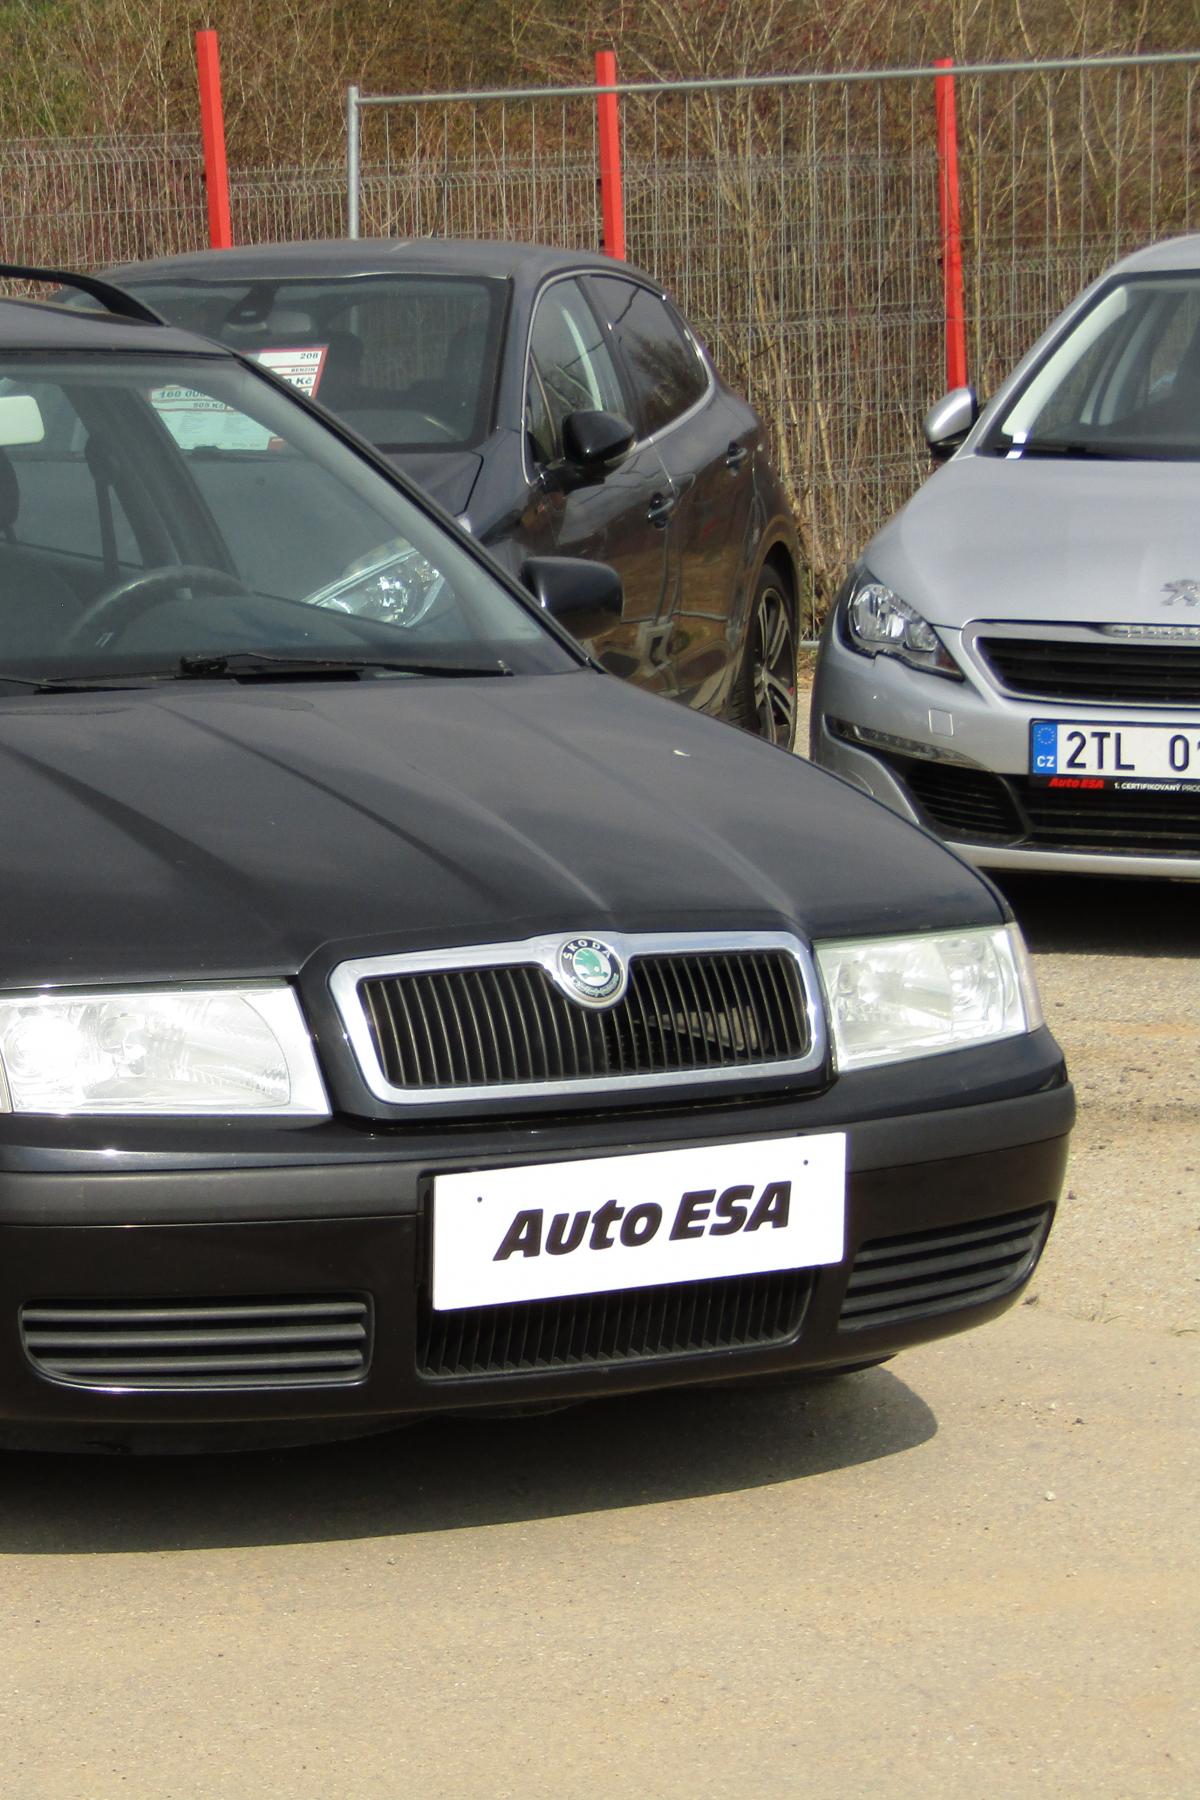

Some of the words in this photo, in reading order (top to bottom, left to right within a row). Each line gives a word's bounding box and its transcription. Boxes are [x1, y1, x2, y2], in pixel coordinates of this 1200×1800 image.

[1037, 756, 1055, 767] CZ
[1066, 731, 1135, 771] 2TL
[1169, 734, 1200, 772] 0
[1049, 778, 1079, 788] Auto
[1080, 779, 1104, 789] ESA
[492, 1200, 662, 1262] Auto
[669, 1181, 792, 1241] ESA
